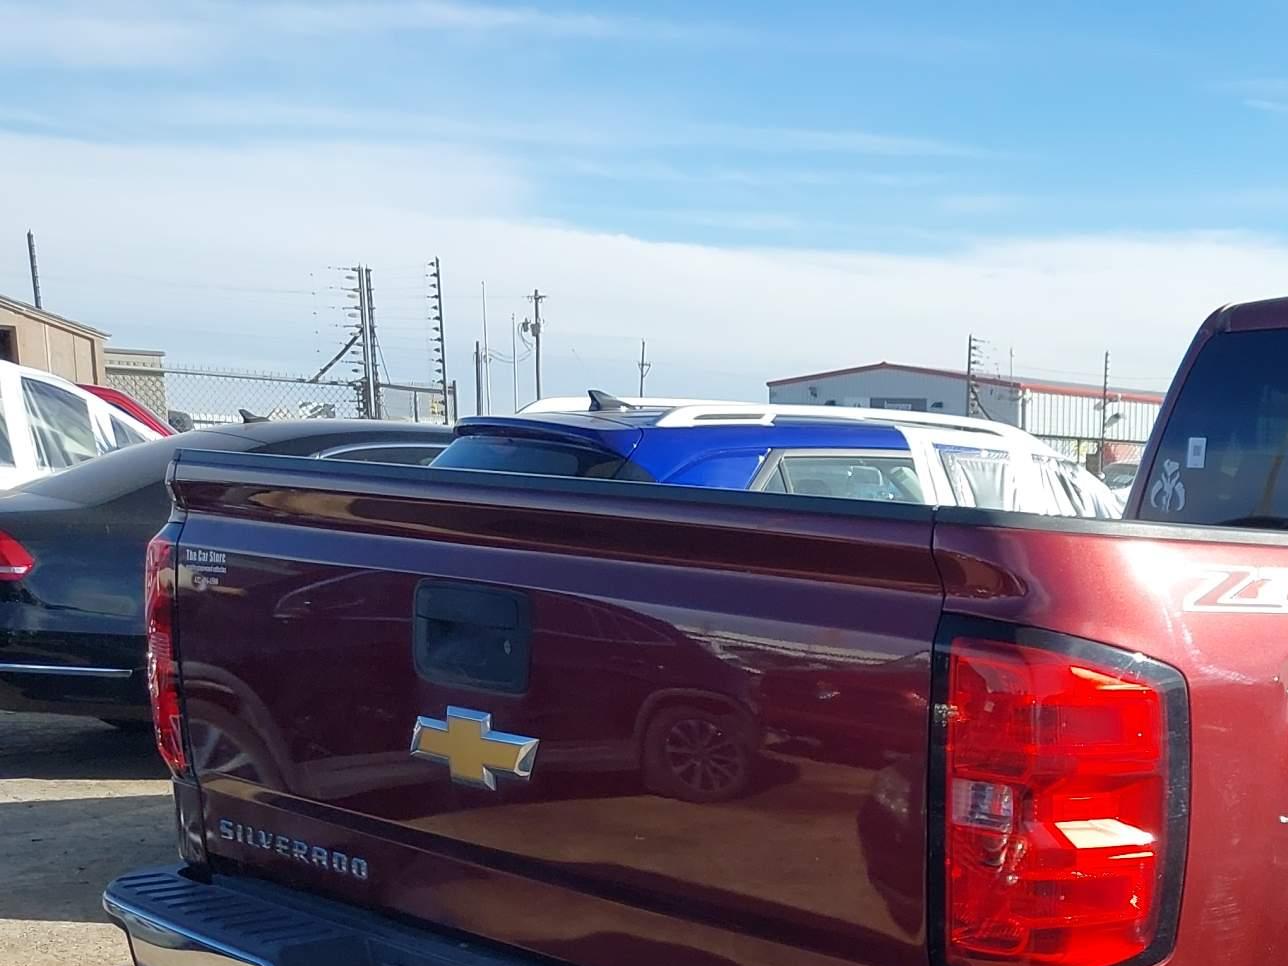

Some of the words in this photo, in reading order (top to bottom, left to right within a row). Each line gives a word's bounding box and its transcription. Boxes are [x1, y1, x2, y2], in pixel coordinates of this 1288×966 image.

[186, 548, 197, 561] The
[198, 549, 208, 562] Car
[209, 551, 226, 563] Store
[219, 819, 369, 880] SILVERADO
